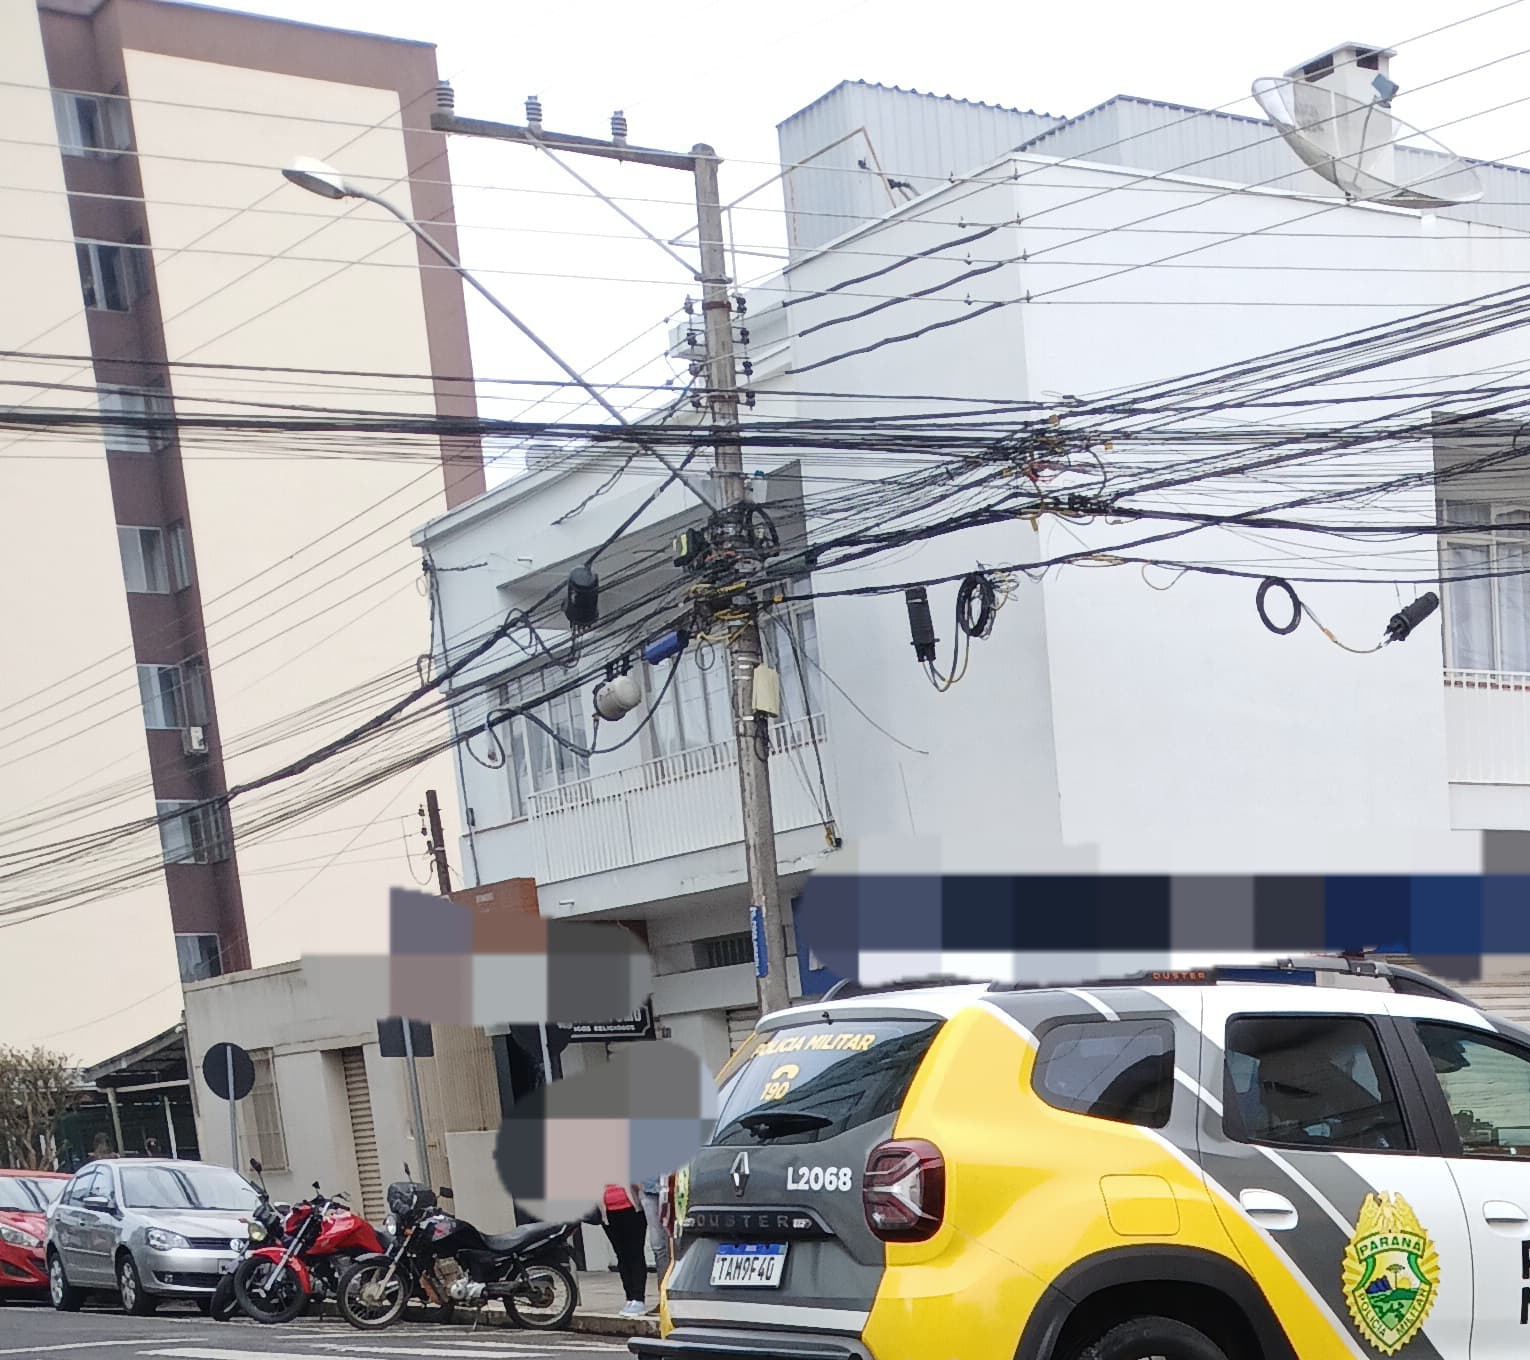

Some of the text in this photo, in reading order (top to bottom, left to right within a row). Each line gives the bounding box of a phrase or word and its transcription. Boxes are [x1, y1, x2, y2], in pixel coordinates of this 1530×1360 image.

[804, 1033, 876, 1052] MILITAR
[760, 1081, 790, 1101] 190
[786, 1166, 852, 1192] L2068
[718, 1256, 775, 1281] TAM9F40
